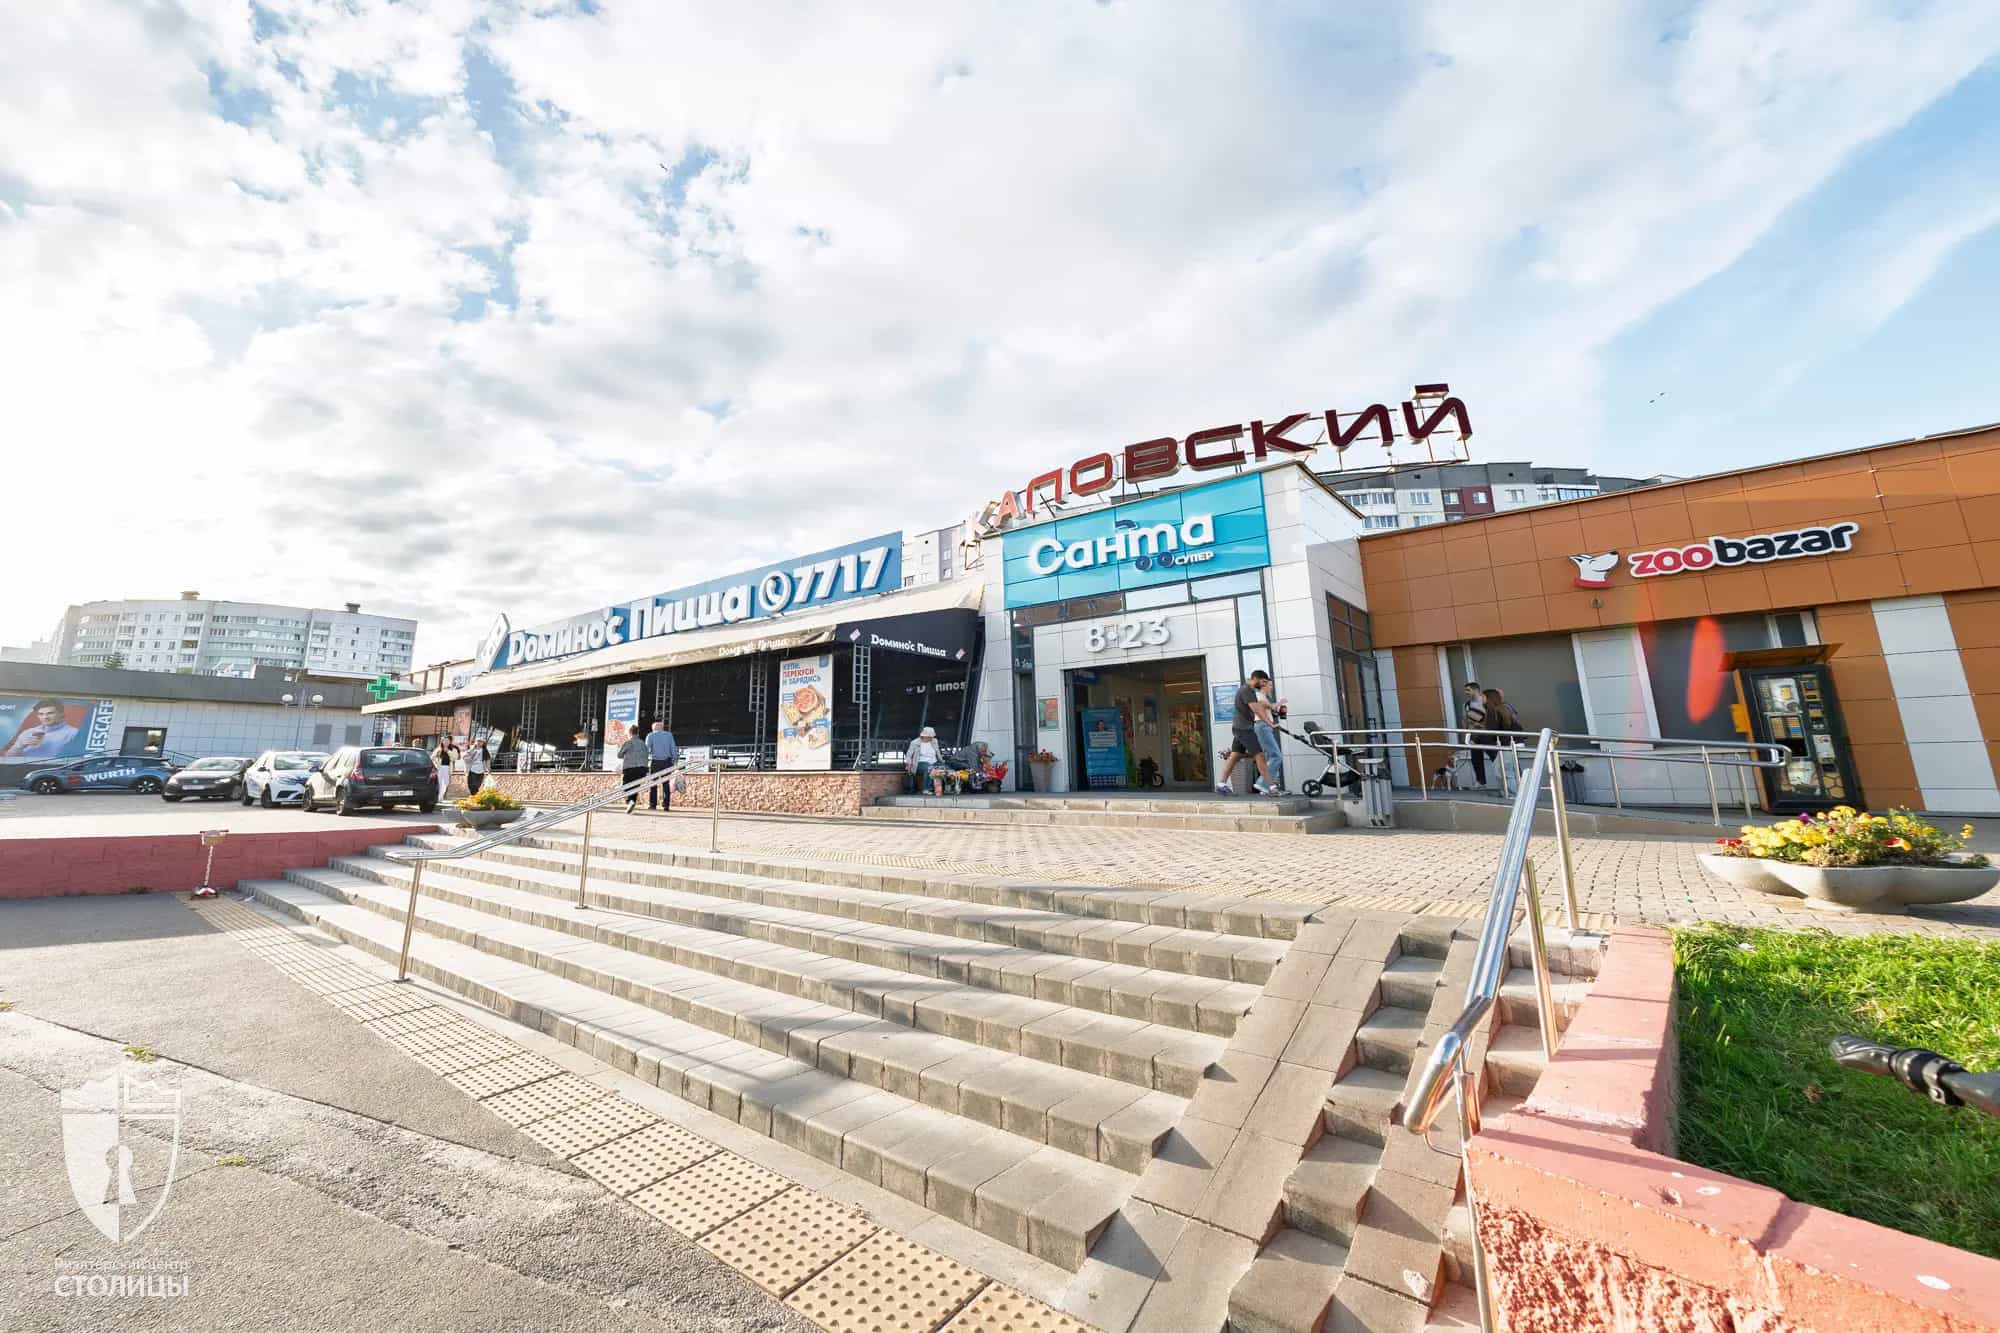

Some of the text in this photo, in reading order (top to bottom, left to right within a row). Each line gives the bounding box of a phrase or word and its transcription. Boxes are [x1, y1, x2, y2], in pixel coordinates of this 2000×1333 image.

[1029, 513, 1215, 576] Санта
[1631, 524, 1856, 577] zoobazar
[629, 585, 748, 641] Пицца
[793, 546, 888, 603] 7717
